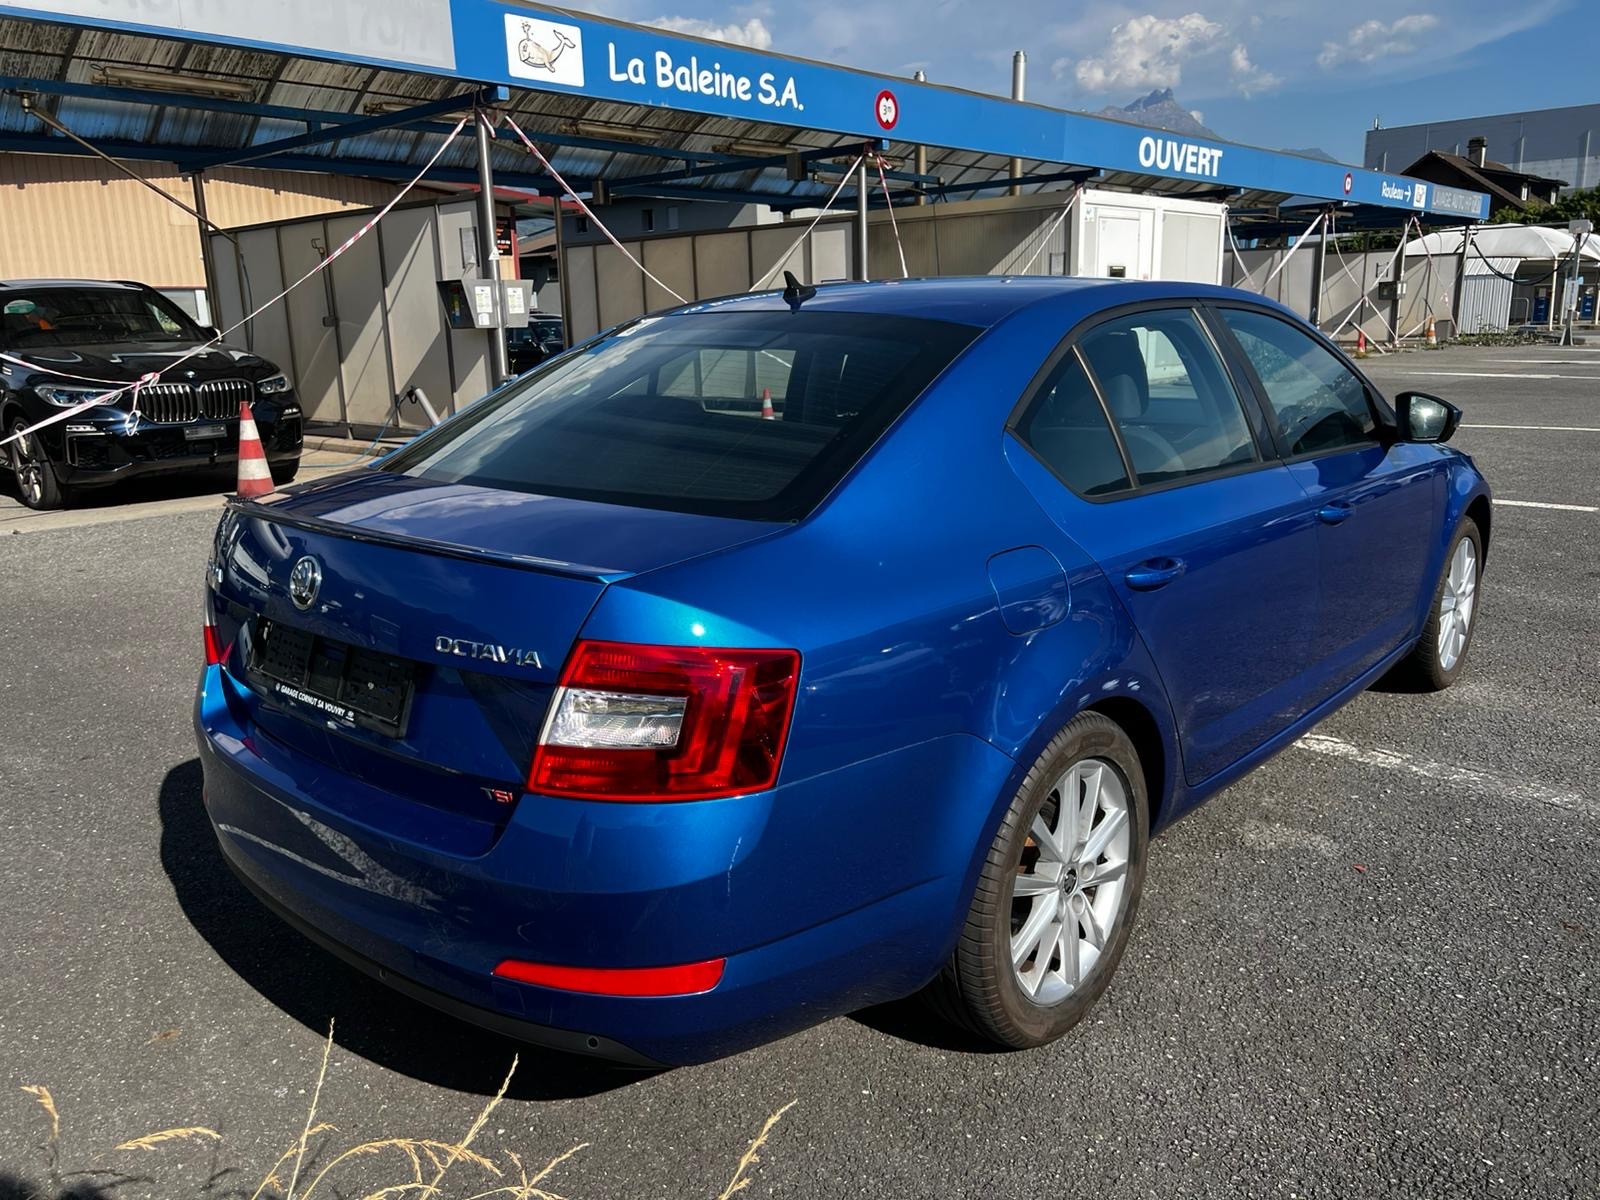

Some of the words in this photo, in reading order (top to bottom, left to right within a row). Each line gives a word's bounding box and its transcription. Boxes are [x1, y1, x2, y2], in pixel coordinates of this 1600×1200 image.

[608, 41, 647, 85] La
[655, 50, 752, 101] Baleine
[757, 72, 804, 111] S.A.
[1138, 136, 1223, 177] OUVERT
[1381, 181, 1404, 201] Rouleau
[435, 635, 542, 669] OCTAVIA
[281, 685, 298, 698] GARAGE
[299, 692, 317, 706] CORNUT
[317, 700, 324, 709] SA
[325, 702, 345, 716] VOUVRY
[480, 787, 513, 803] TSI
